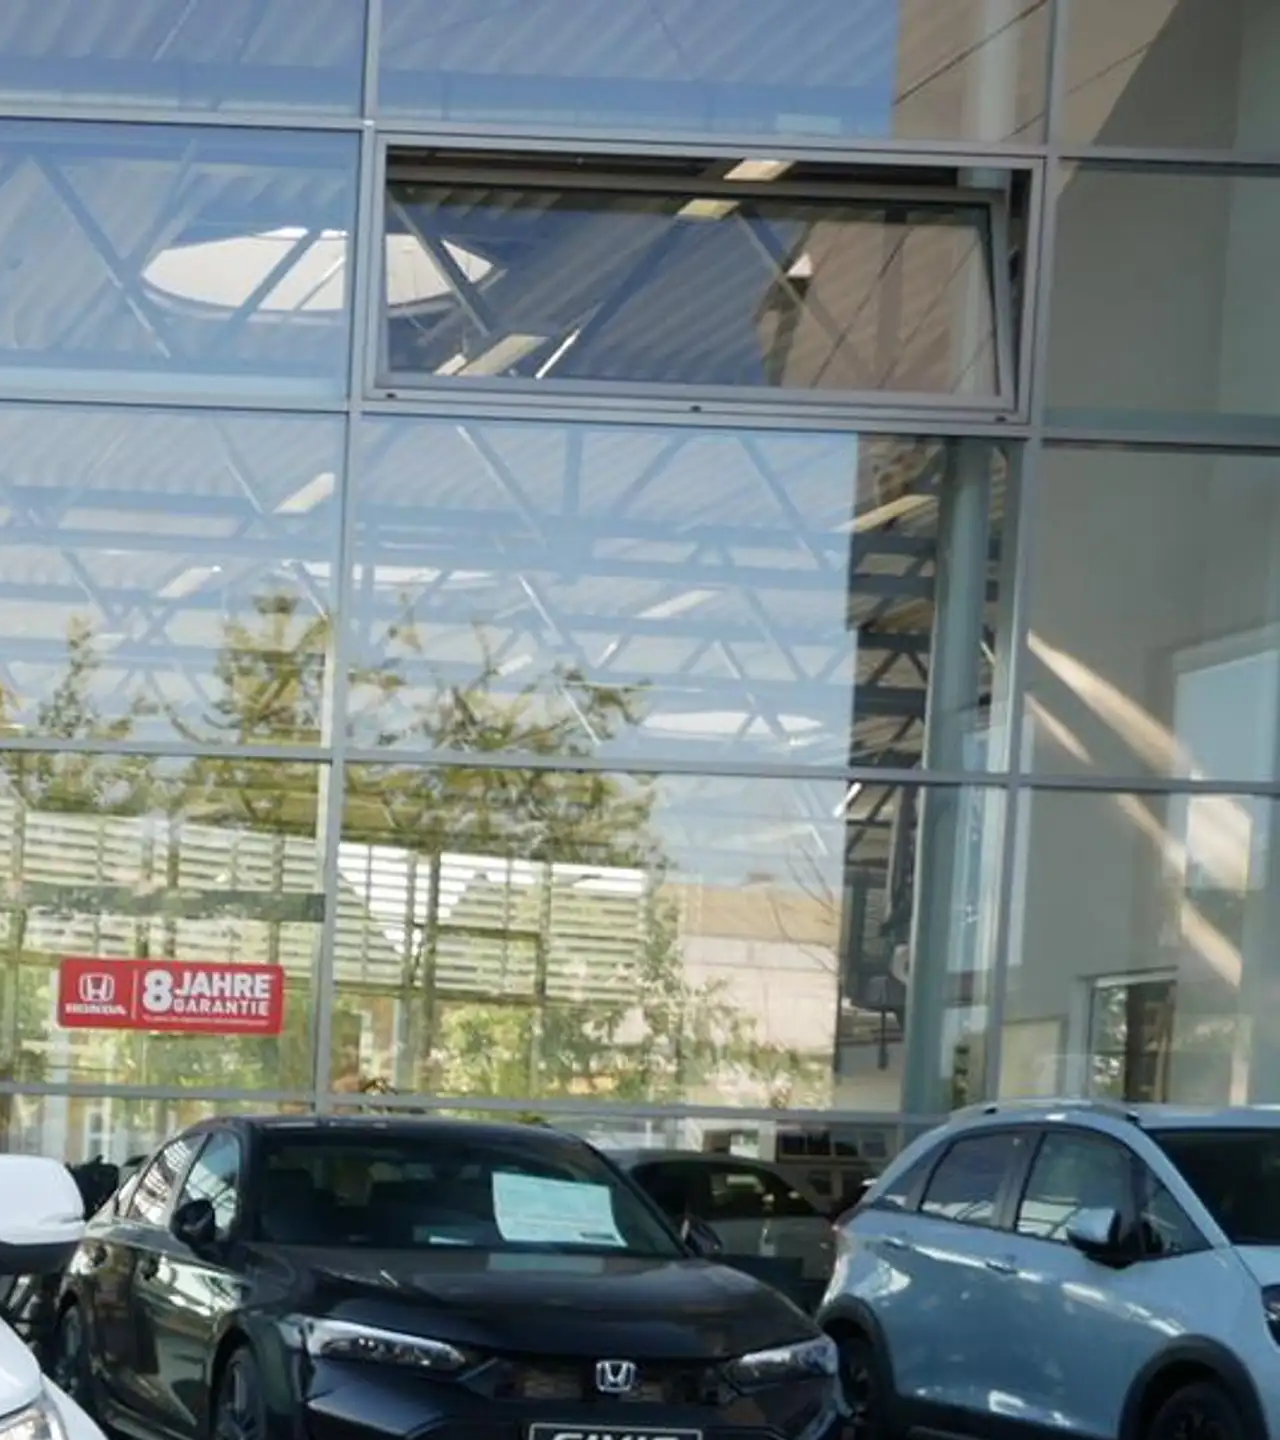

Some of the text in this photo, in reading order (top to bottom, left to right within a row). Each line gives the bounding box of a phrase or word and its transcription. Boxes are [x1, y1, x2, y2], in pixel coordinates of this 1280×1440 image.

[143, 969, 273, 1012] 8 JAHRE
[174, 999, 269, 1017] GARANTIE
